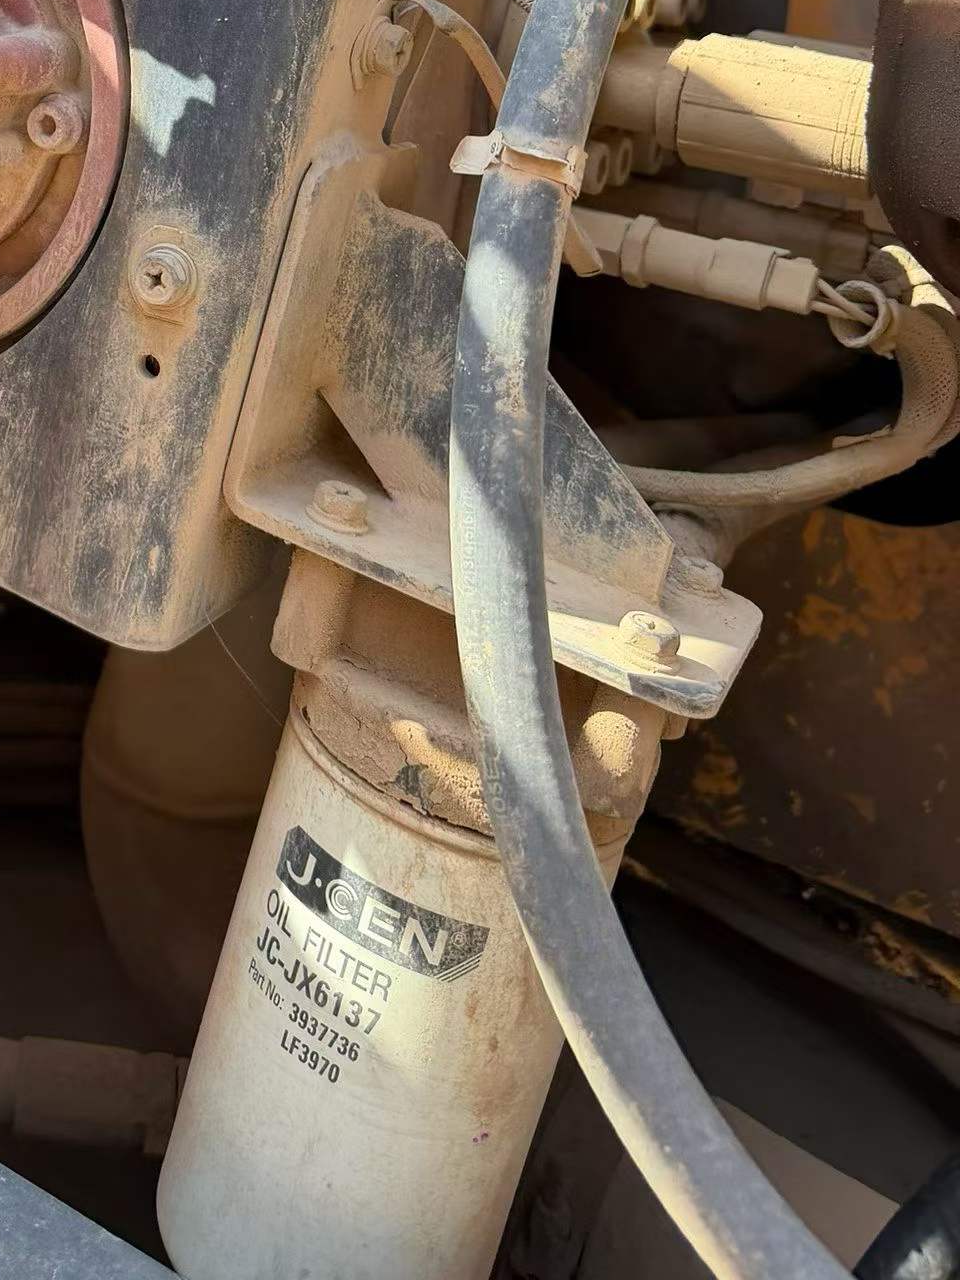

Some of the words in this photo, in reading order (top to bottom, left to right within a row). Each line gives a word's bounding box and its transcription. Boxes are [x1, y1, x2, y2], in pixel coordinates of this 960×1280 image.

[256, 926, 382, 1035] JC-JX6137
[267, 888, 291, 938] OIL
[302, 925, 393, 1003] FILTER
[248, 957, 266, 991] Part
[264, 983, 285, 1011] No:
[289, 1003, 361, 1063] 3937736
[280, 1028, 341, 1084] LF3970
